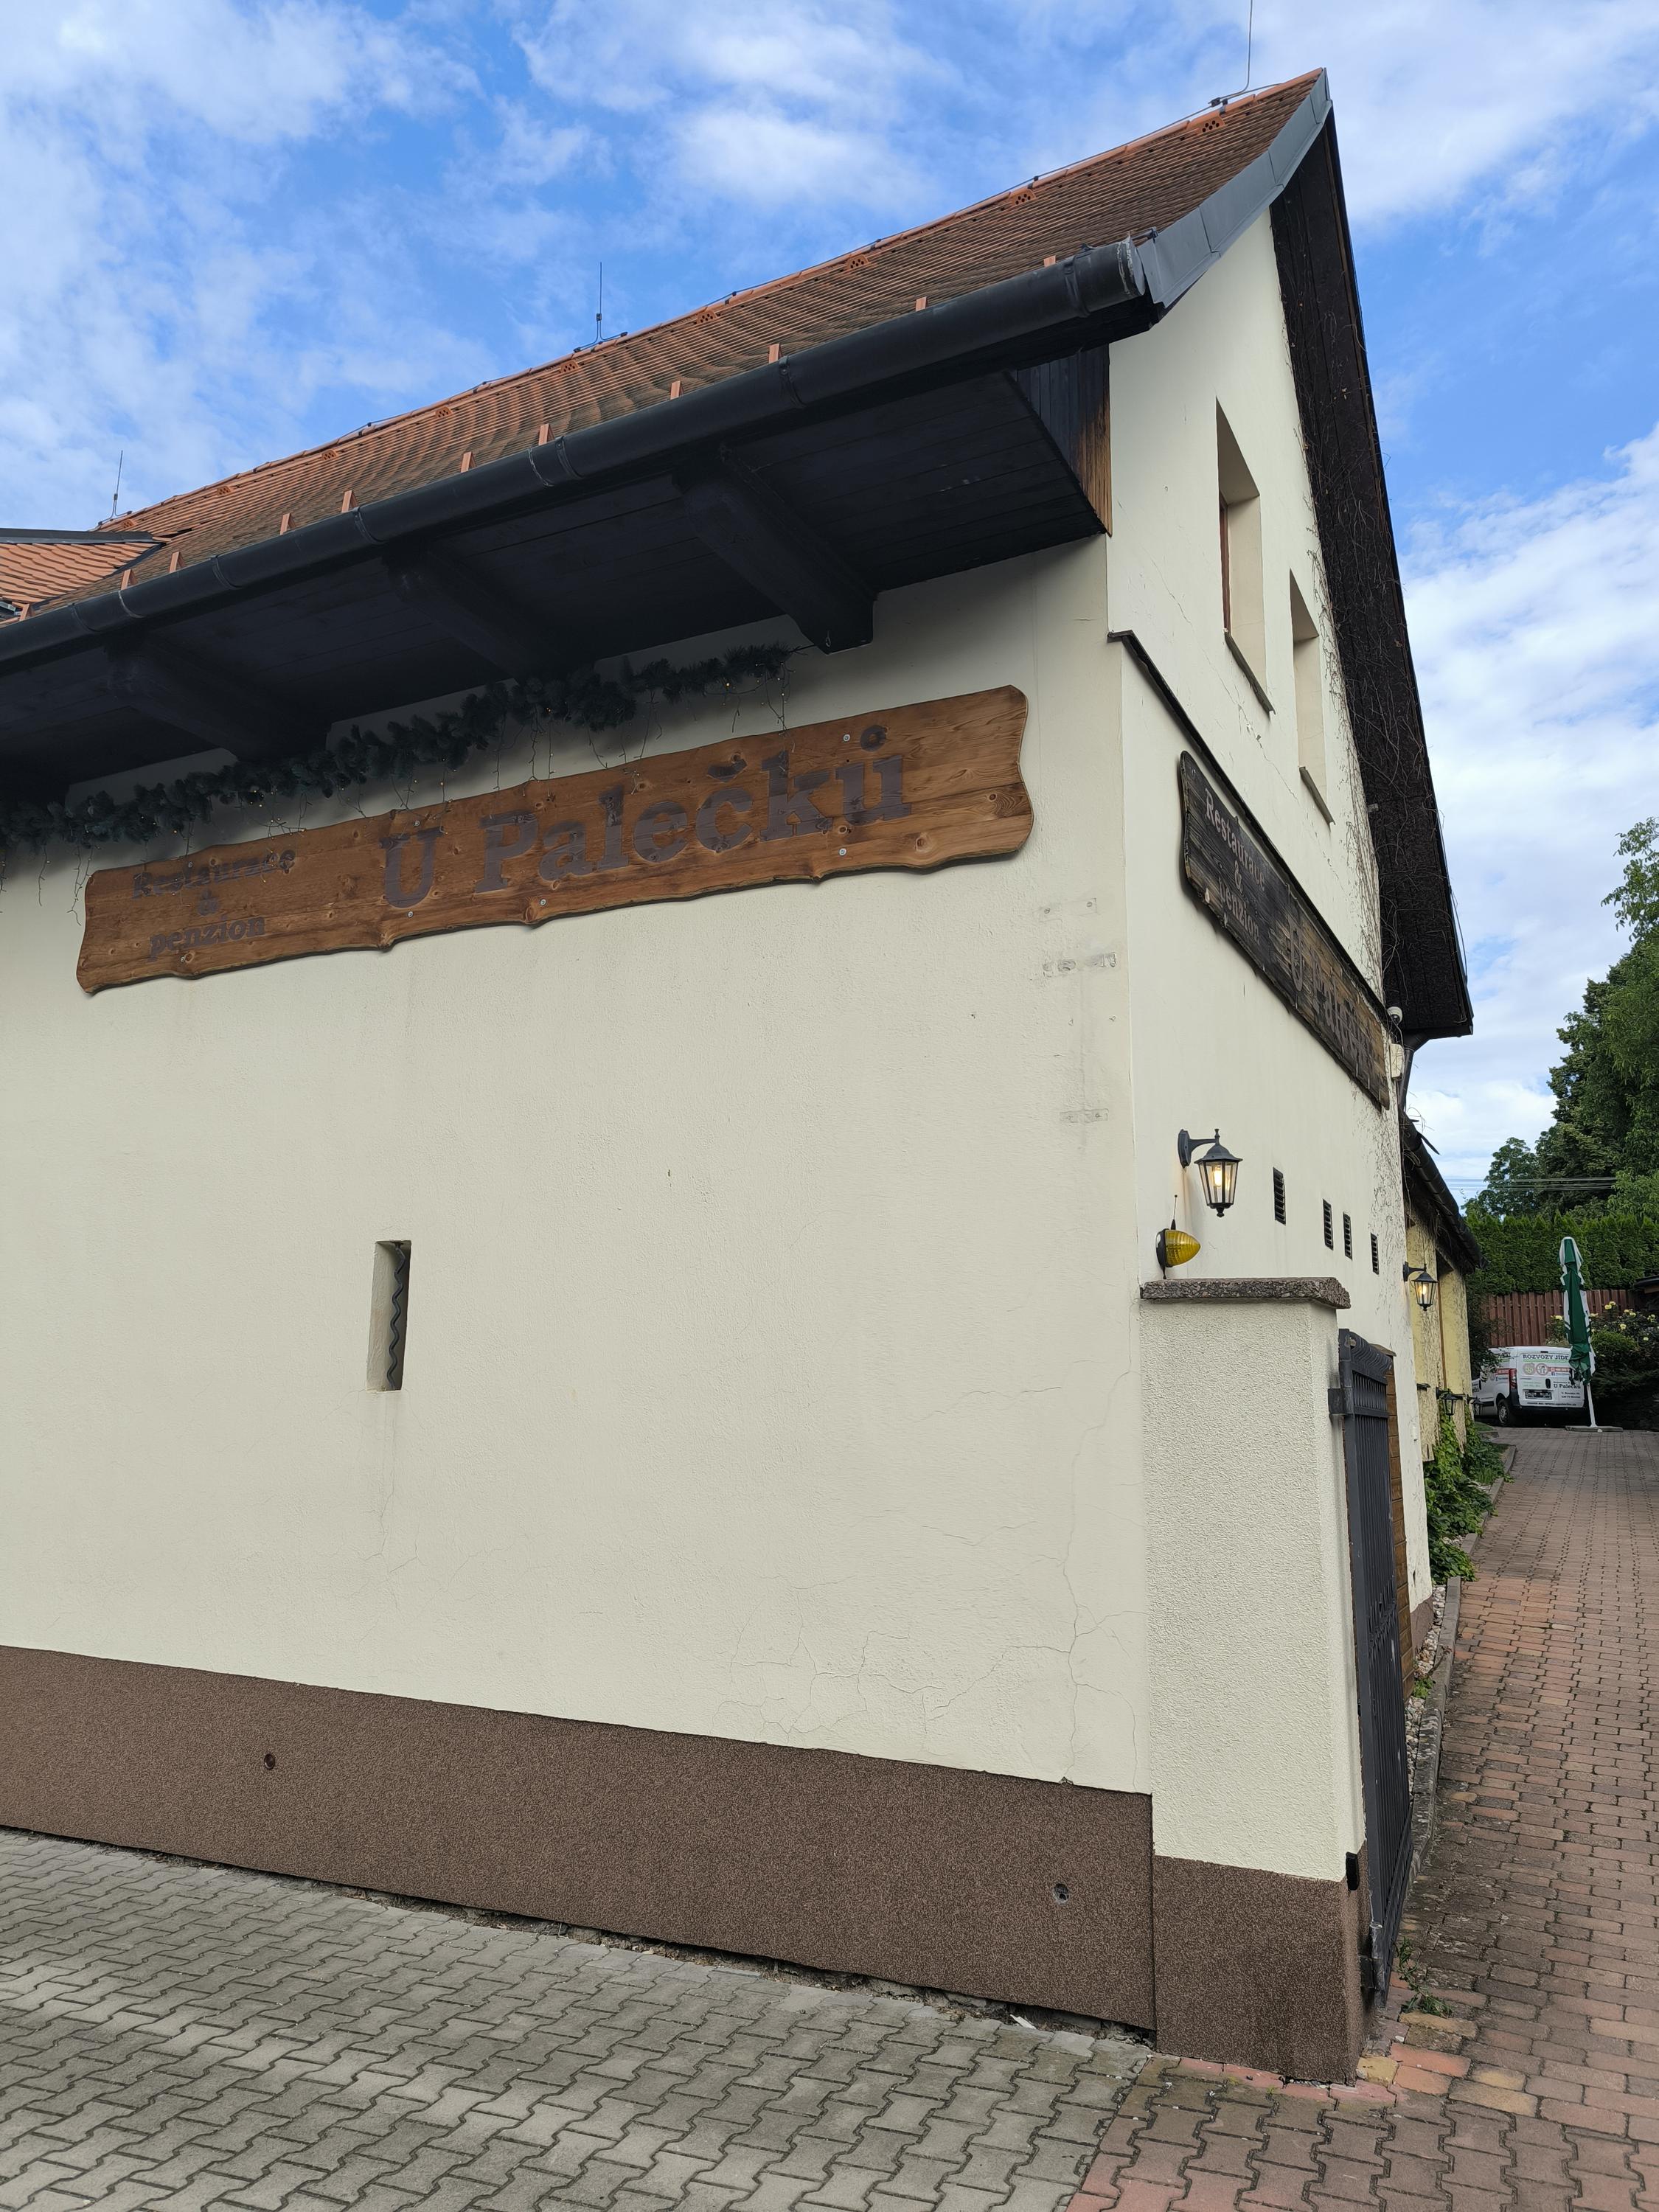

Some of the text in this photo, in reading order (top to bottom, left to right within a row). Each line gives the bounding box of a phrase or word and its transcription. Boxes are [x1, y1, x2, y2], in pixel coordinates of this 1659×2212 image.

[378, 724, 911, 908] U Palečků
[1206, 788, 1266, 892] Restaurace
[1234, 860, 1243, 894] &
[196, 888, 220, 917] &
[146, 914, 266, 963] penzion
